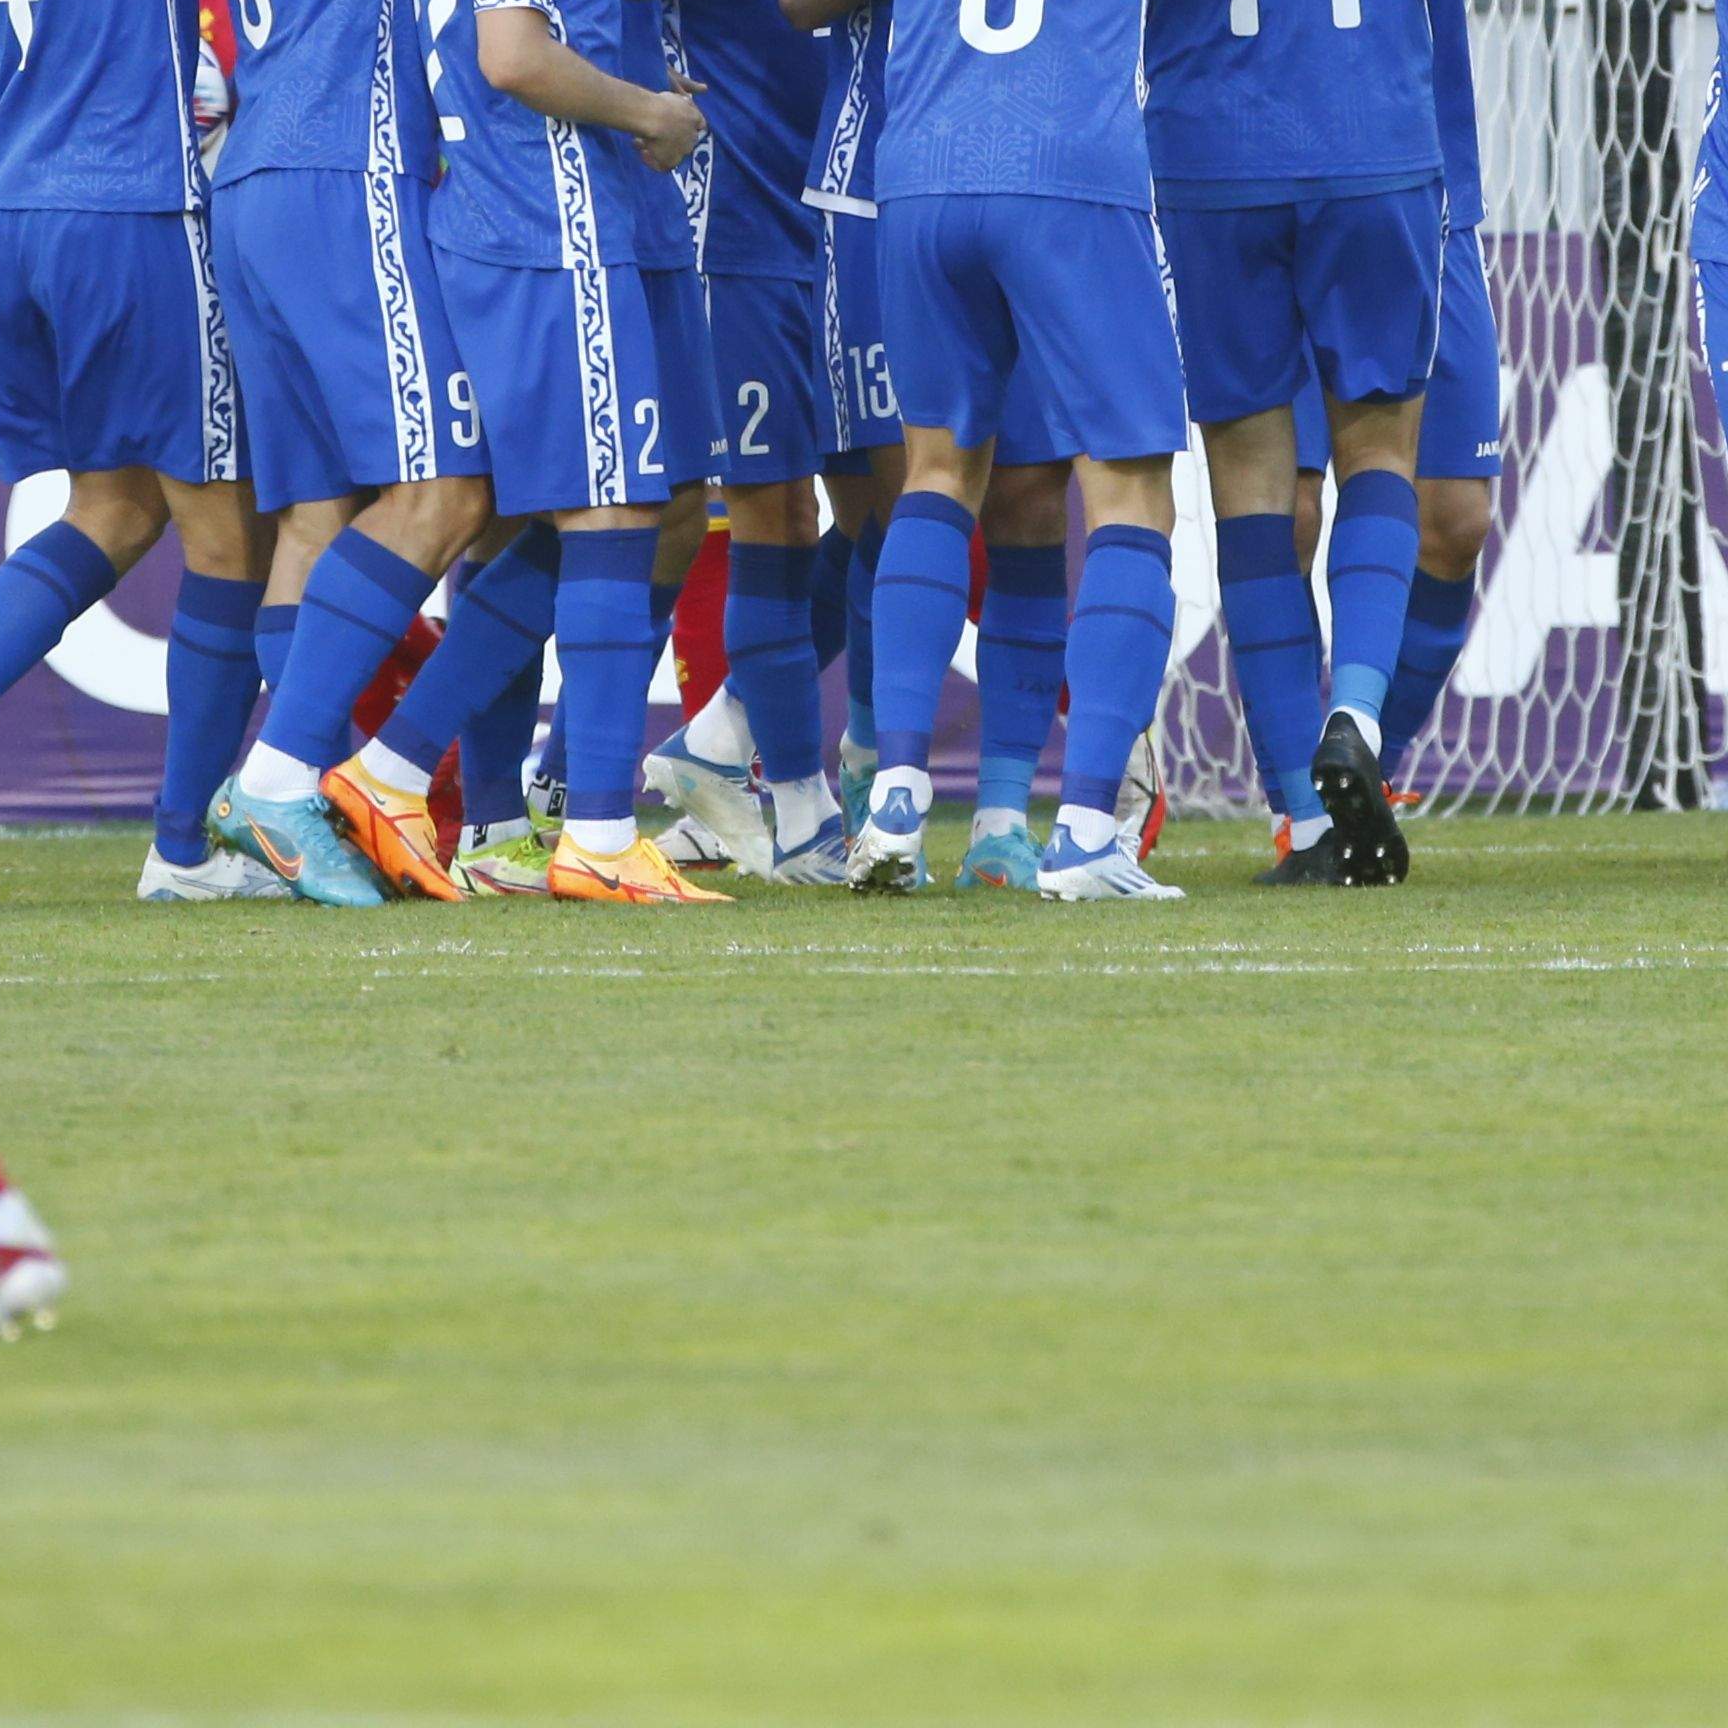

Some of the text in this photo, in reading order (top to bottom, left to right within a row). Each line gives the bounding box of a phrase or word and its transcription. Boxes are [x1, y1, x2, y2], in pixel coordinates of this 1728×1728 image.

[446, 370, 481, 448] 9
[737, 380, 770, 456] 2
[848, 346, 895, 421] 13
